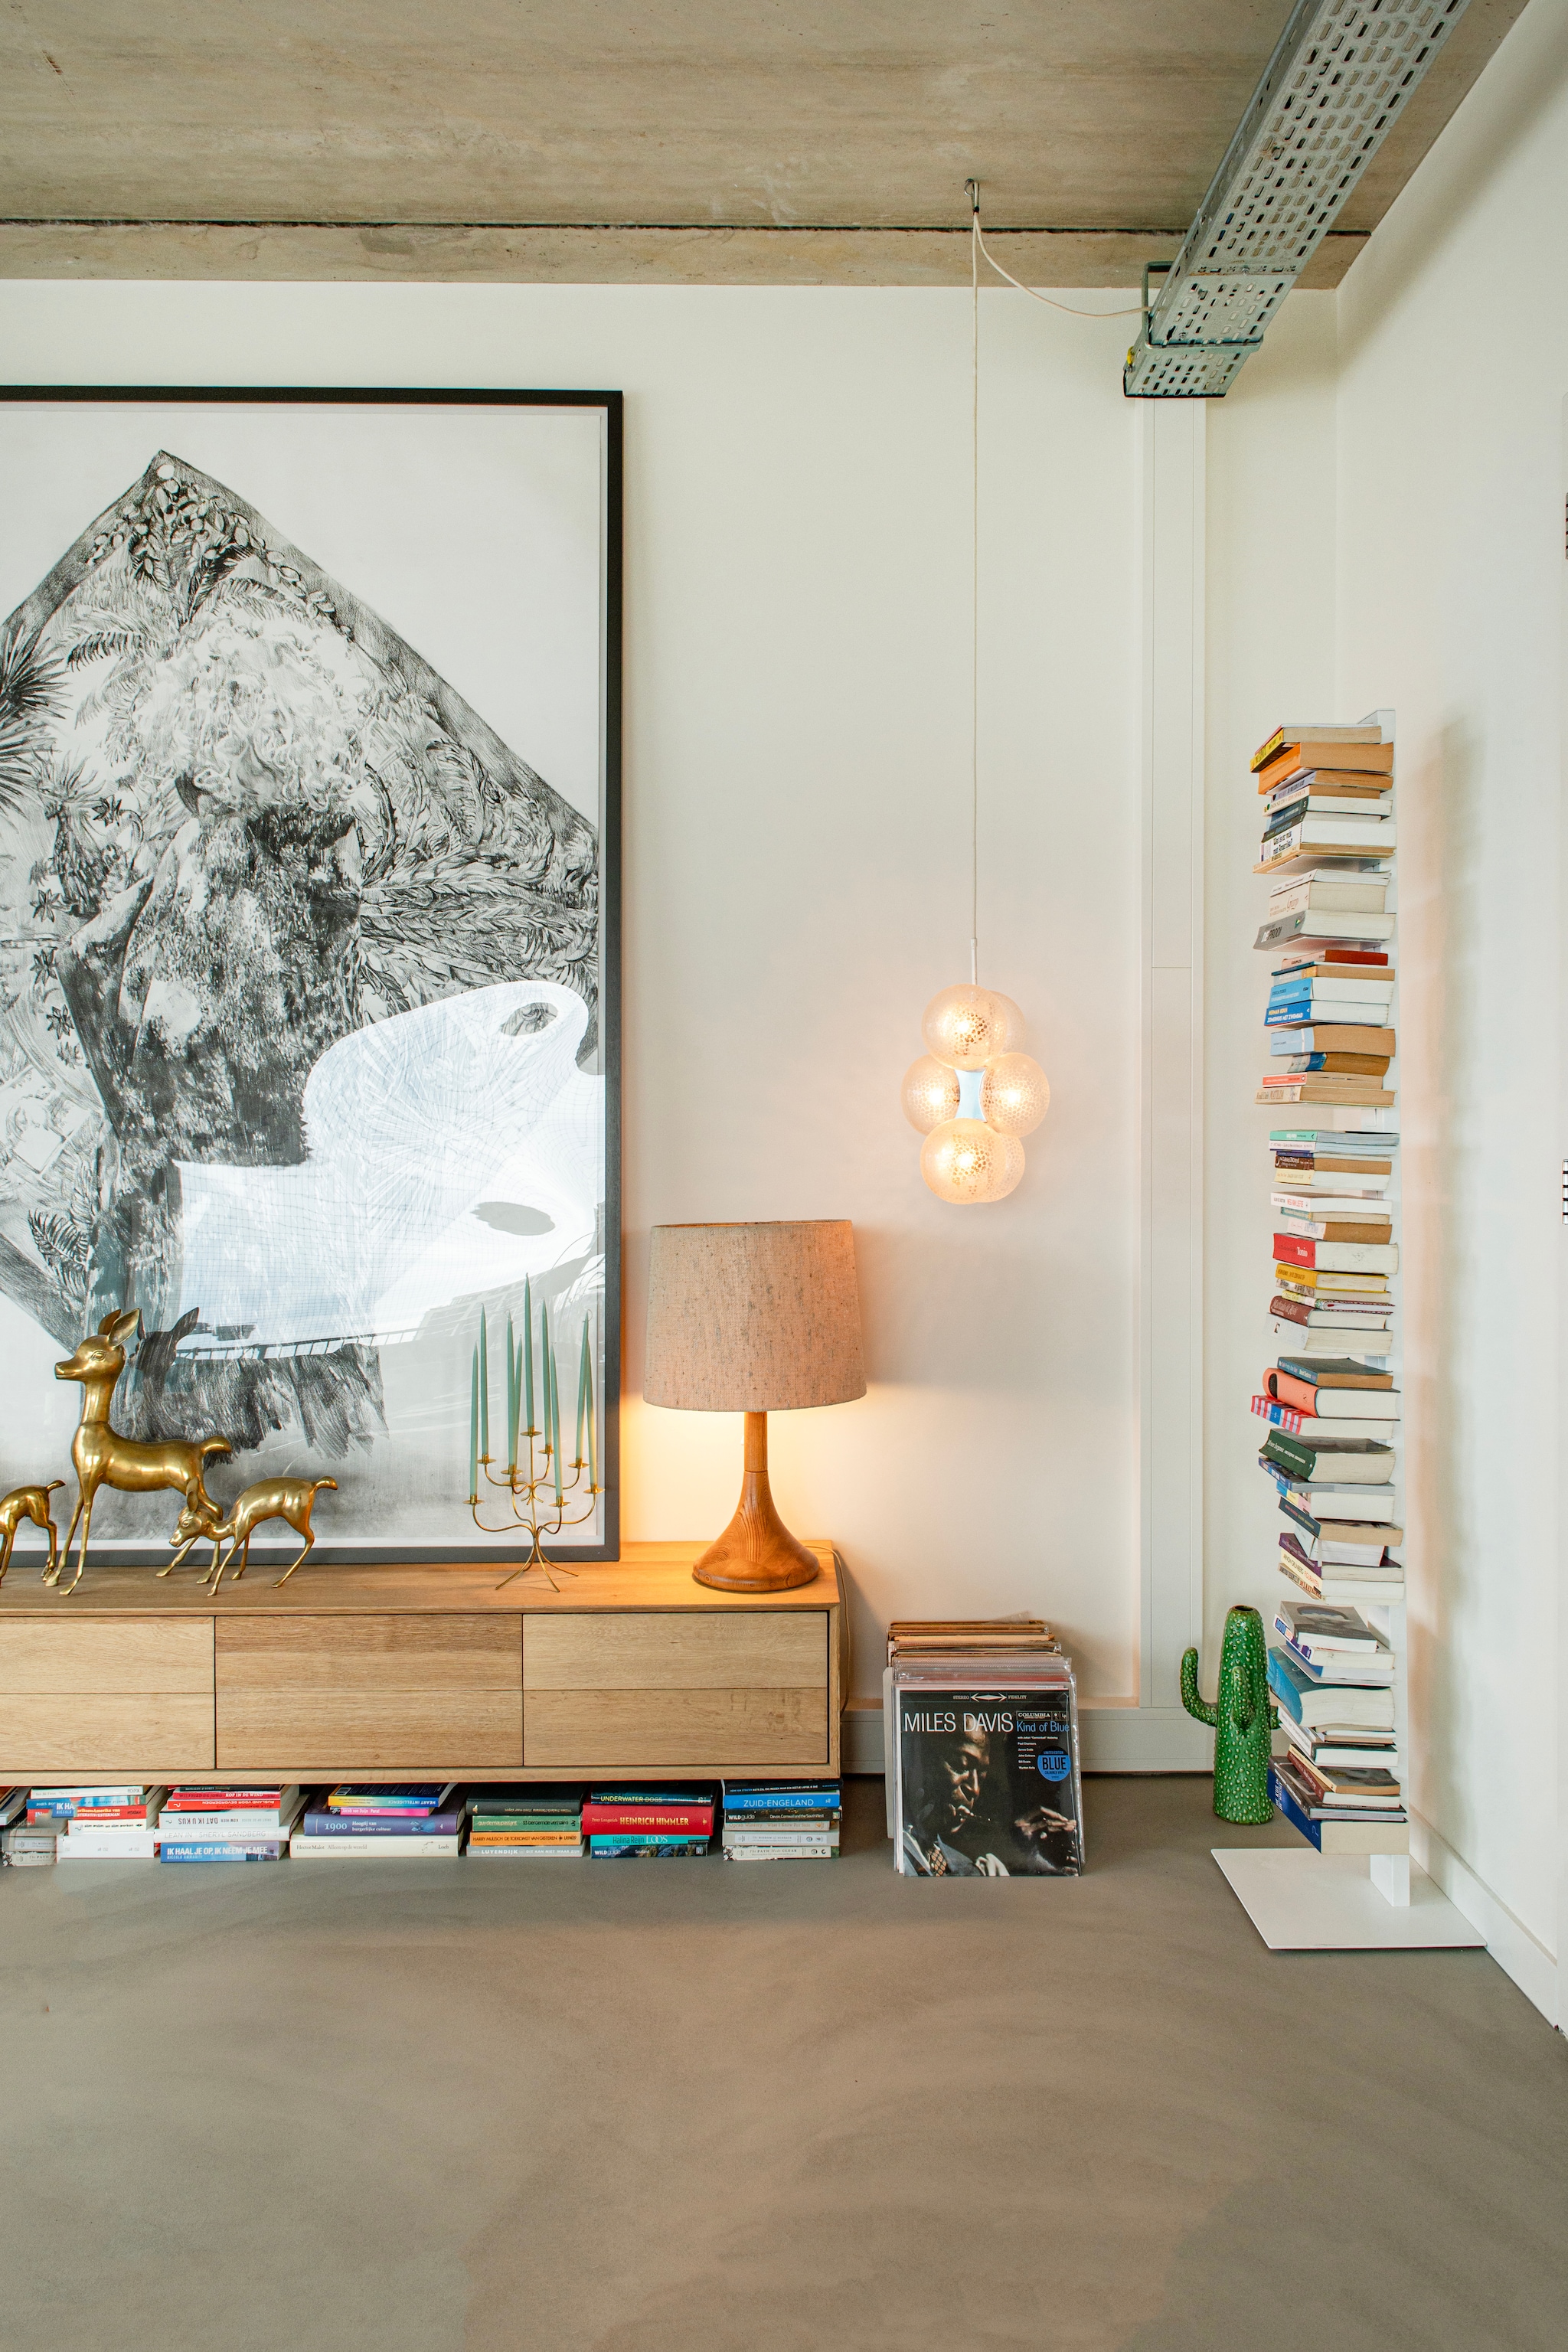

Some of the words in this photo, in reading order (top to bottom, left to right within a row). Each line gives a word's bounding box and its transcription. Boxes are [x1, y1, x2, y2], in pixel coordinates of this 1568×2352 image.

[1296, 1246, 1308, 1257] Tonio
[904, 1712, 956, 1733] MILES
[963, 1712, 1014, 1733] DAVIS
[1016, 1720, 1037, 1732] Kind
[1039, 1721, 1049, 1732] of
[1050, 1720, 1070, 1733] Blue
[1042, 1757, 1067, 1770] BLUE
[324, 1822, 348, 1831] 1900
[619, 1817, 655, 1825] HEINRICH
[656, 1817, 689, 1826] HIMMLER
[631, 1836, 645, 1845] Reijn
[645, 1835, 668, 1844] LOOS
[204, 1847, 214, 1856] OP,
[253, 1846, 268, 1854] MEE
